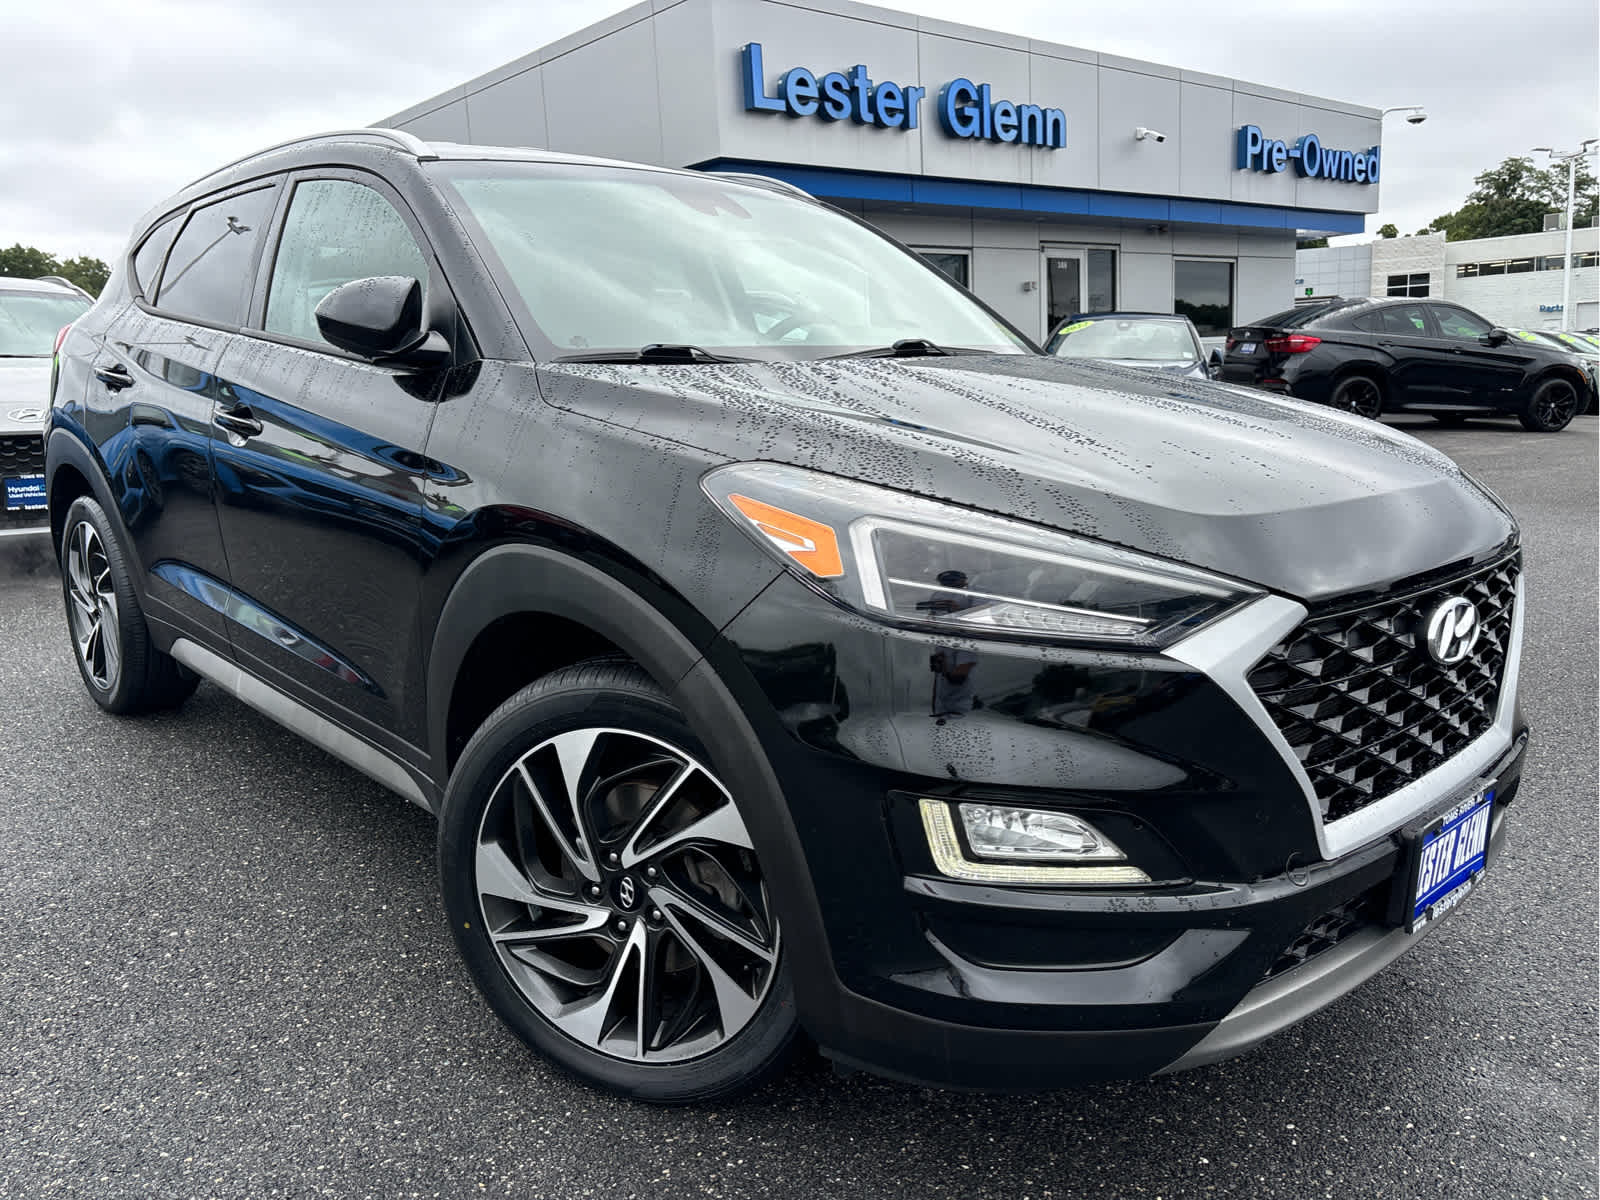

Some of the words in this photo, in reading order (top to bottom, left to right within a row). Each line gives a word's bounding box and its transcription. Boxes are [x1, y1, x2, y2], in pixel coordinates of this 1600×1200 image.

[742, 42, 925, 129] Lester
[938, 77, 1067, 149] Glenn
[1237, 124, 1380, 184] Pre-Owned
[7, 485, 40, 493] Hyundai
[1442, 807, 1459, 827] TOMS
[1416, 829, 1457, 900] LESTER
[1453, 804, 1491, 870] GLENN
